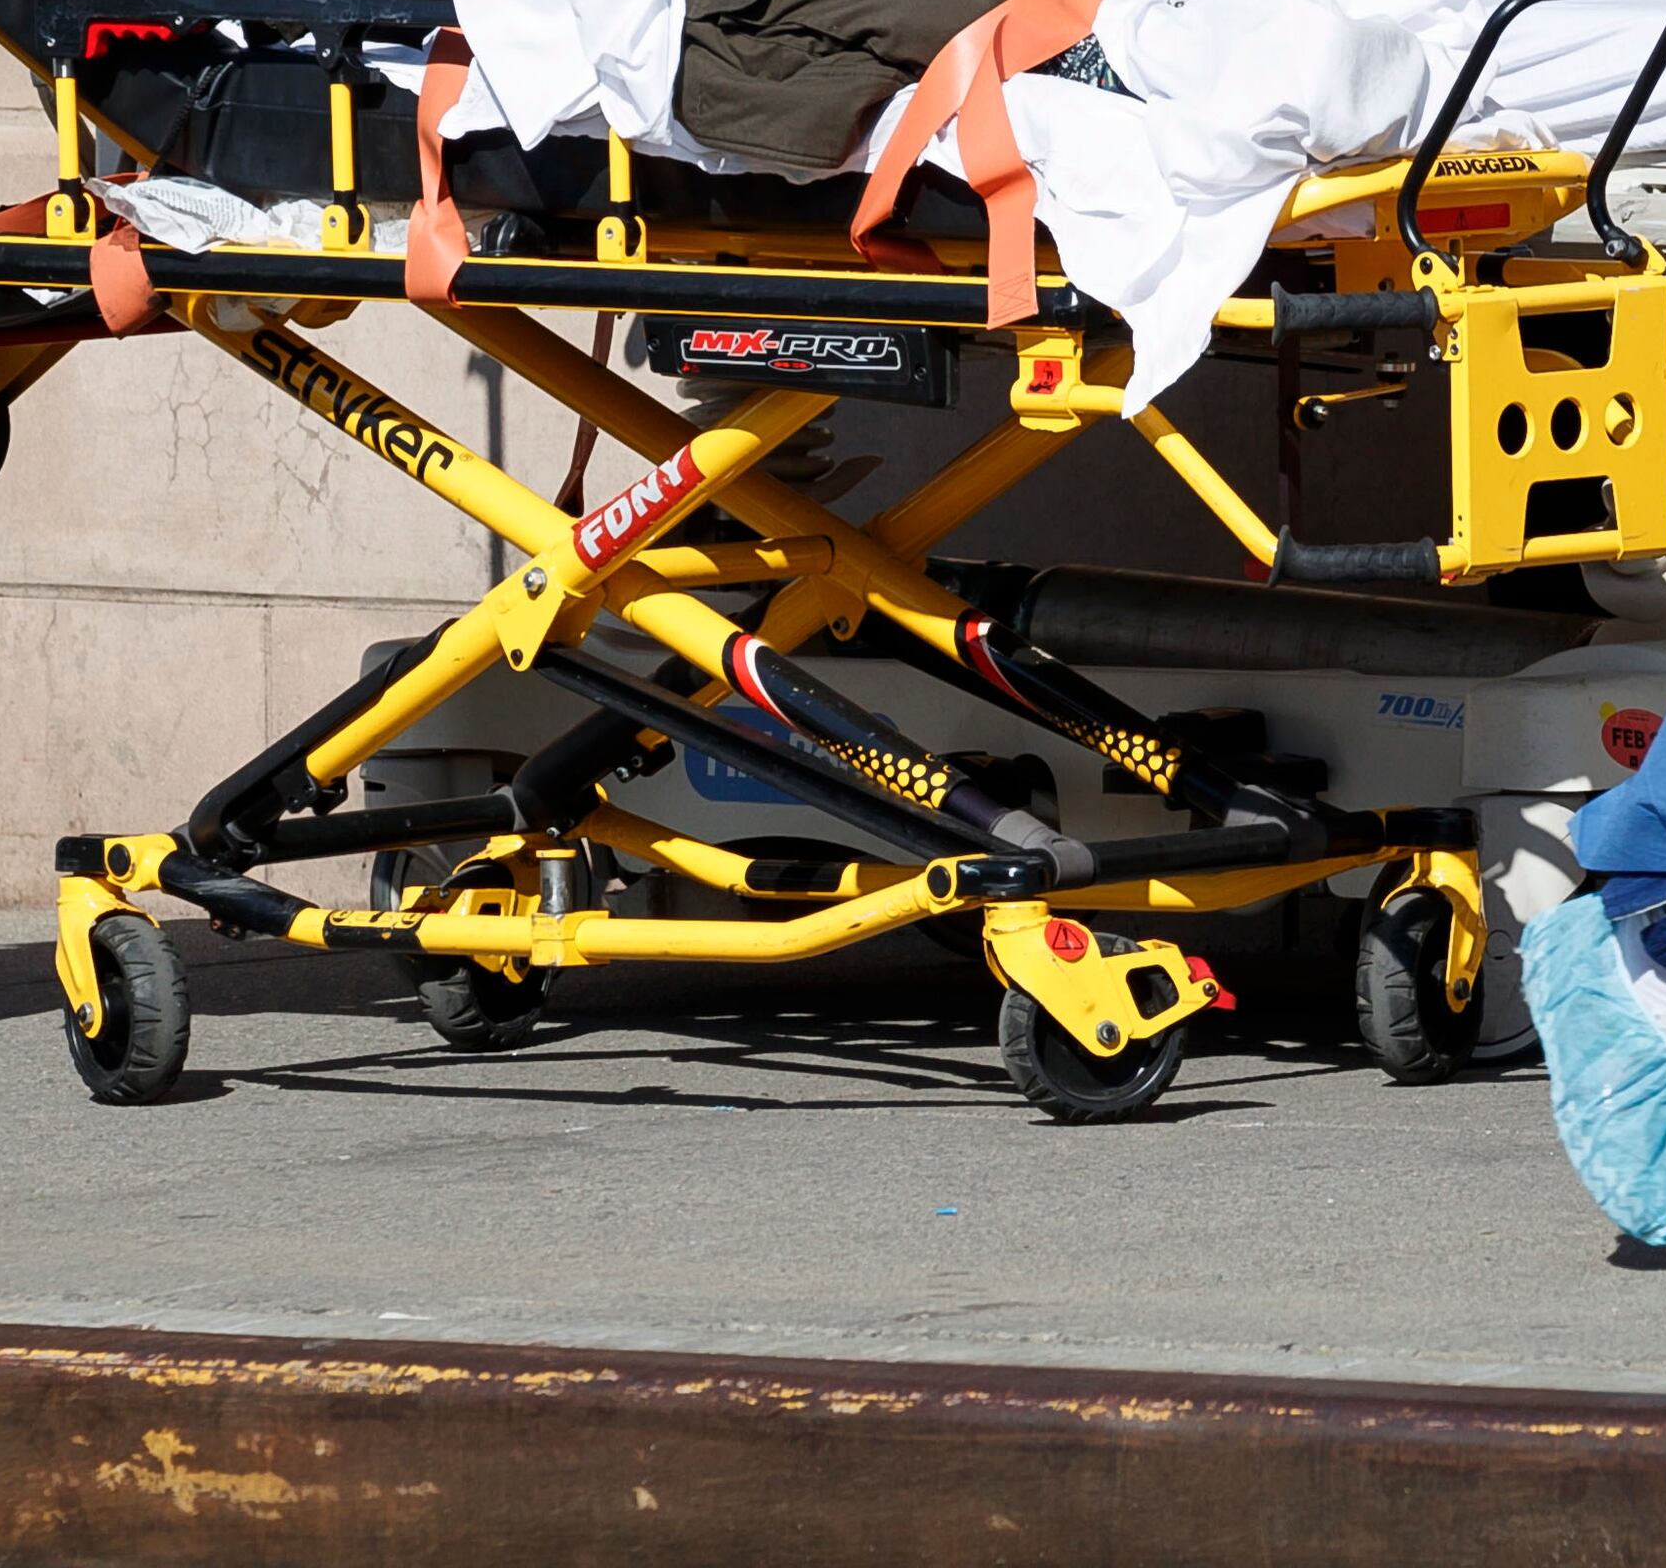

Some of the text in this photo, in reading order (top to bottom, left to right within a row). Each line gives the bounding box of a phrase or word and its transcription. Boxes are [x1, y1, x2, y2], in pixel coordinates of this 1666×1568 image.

[1442, 156, 1528, 177] RUGGED
[689, 329, 890, 362] MX-PRO
[241, 328, 454, 483] stryker
[1612, 727, 1646, 750] FEB
